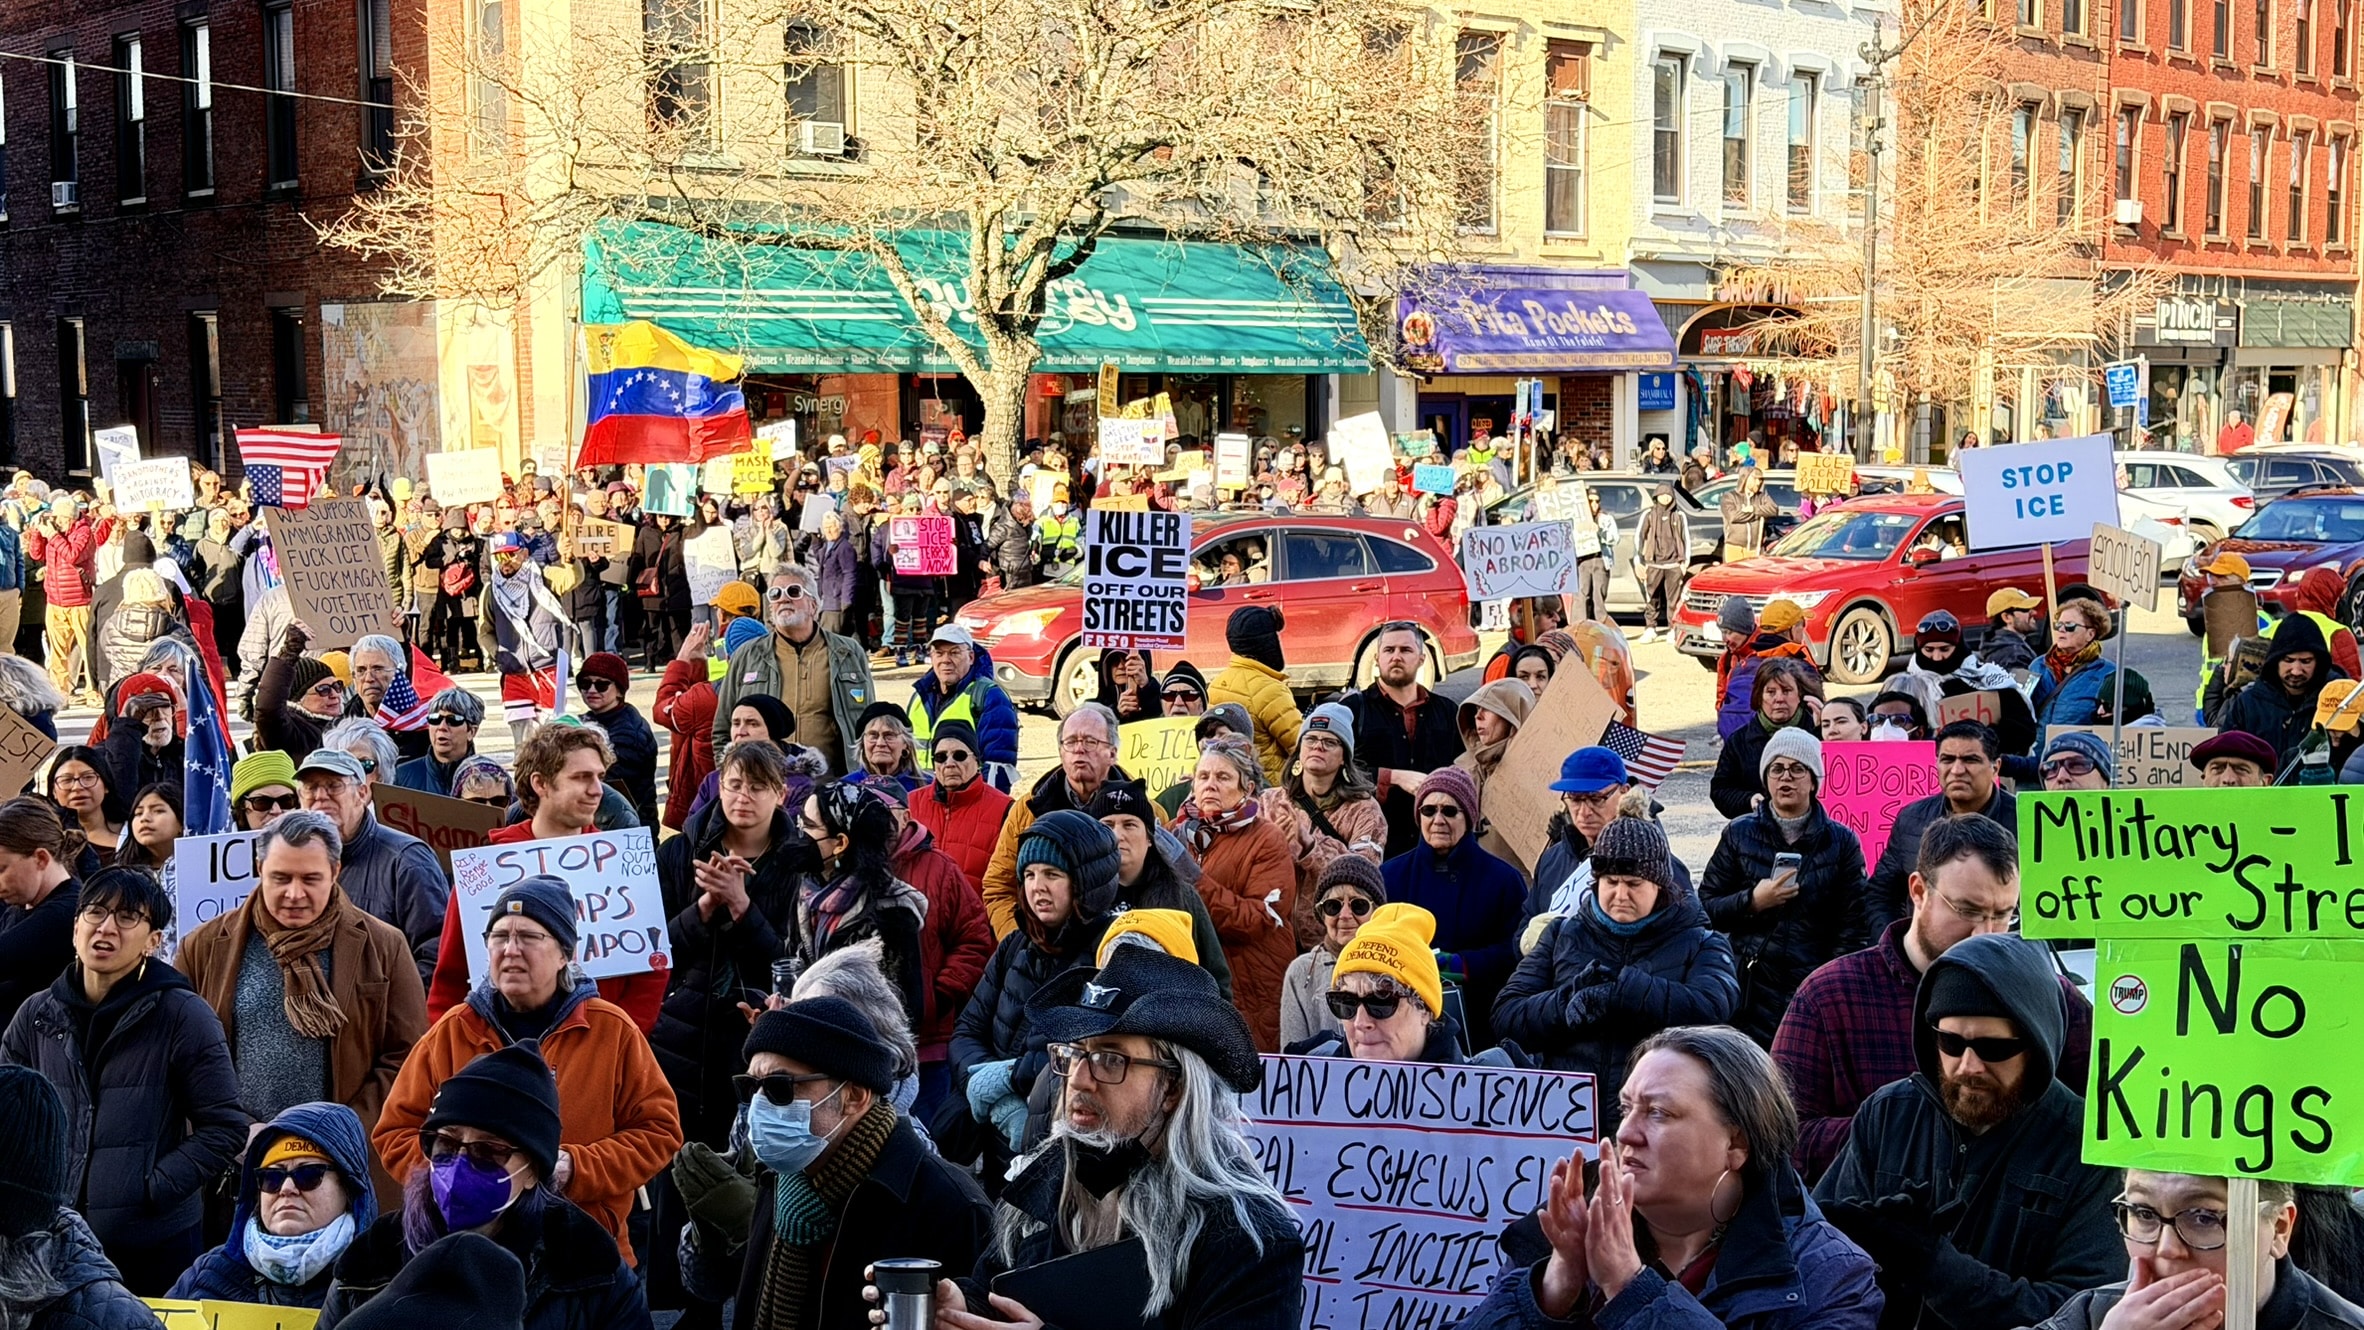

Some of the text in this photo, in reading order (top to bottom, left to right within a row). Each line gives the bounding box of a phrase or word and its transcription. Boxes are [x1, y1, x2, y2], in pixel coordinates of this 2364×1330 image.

[1458, 299, 1638, 336] Pita Pockets
[2160, 302, 2212, 329] PINCH
[785, 355, 814, 366] Wearable
[815, 355, 844, 366] Fashions
[852, 355, 870, 365] Shoes
[1046, 356, 1072, 366] Wearable
[1167, 356, 1191, 366] Wearable
[1220, 356, 1236, 366] Shoes
[1274, 356, 1297, 366] Wearable
[794, 394, 851, 415] Synergy
[735, 456, 770, 467] MASK
[739, 471, 767, 482] ICE
[1800, 466, 1850, 478] SECRET
[2002, 461, 2073, 489] STOP
[134, 478, 167, 487] AGAINST
[1800, 478, 1848, 490] POLICE
[130, 487, 180, 503] AUTOCRACY
[274, 501, 364, 523] WE SUPPORT
[2015, 494, 2065, 519] ICE
[575, 525, 615, 537] FIRE
[920, 517, 948, 531] STOP
[1098, 510, 1181, 547] KILLER
[280, 523, 371, 546] IMMIGRANTS
[927, 532, 946, 545] ICE
[1480, 536, 1505, 556] NO
[1511, 528, 1558, 551] WARS
[287, 547, 333, 567] FUCK
[582, 542, 611, 553] ICE
[919, 546, 950, 559] TERROR
[927, 560, 952, 572] NOW
[1088, 545, 1186, 579] ICE
[1486, 550, 1559, 575] ABROAD
[2092, 533, 2152, 594] enough
[1087, 583, 1185, 598] OFF OUR
[306, 592, 388, 613] VOTE THEM
[330, 614, 380, 634] OUT!
[1084, 597, 1185, 633] STREETS
[2147, 763, 2182, 785] and
[624, 834, 652, 850] ICE
[2033, 795, 2239, 873] Military
[495, 839, 618, 890] STOP
[622, 850, 651, 863] OUT
[621, 863, 657, 877] NOW!
[2035, 875, 2102, 921] off
[2121, 891, 2203, 920] our
[1357, 940, 1398, 957] DEFEND
[1345, 950, 1405, 971] DEMOCRACY
[2114, 986, 2144, 1000] TRUMP
[2176, 943, 2306, 1039] No
[1344, 1064, 1594, 1133] CONSCIENCE
[2096, 1038, 2333, 1173] Kings
